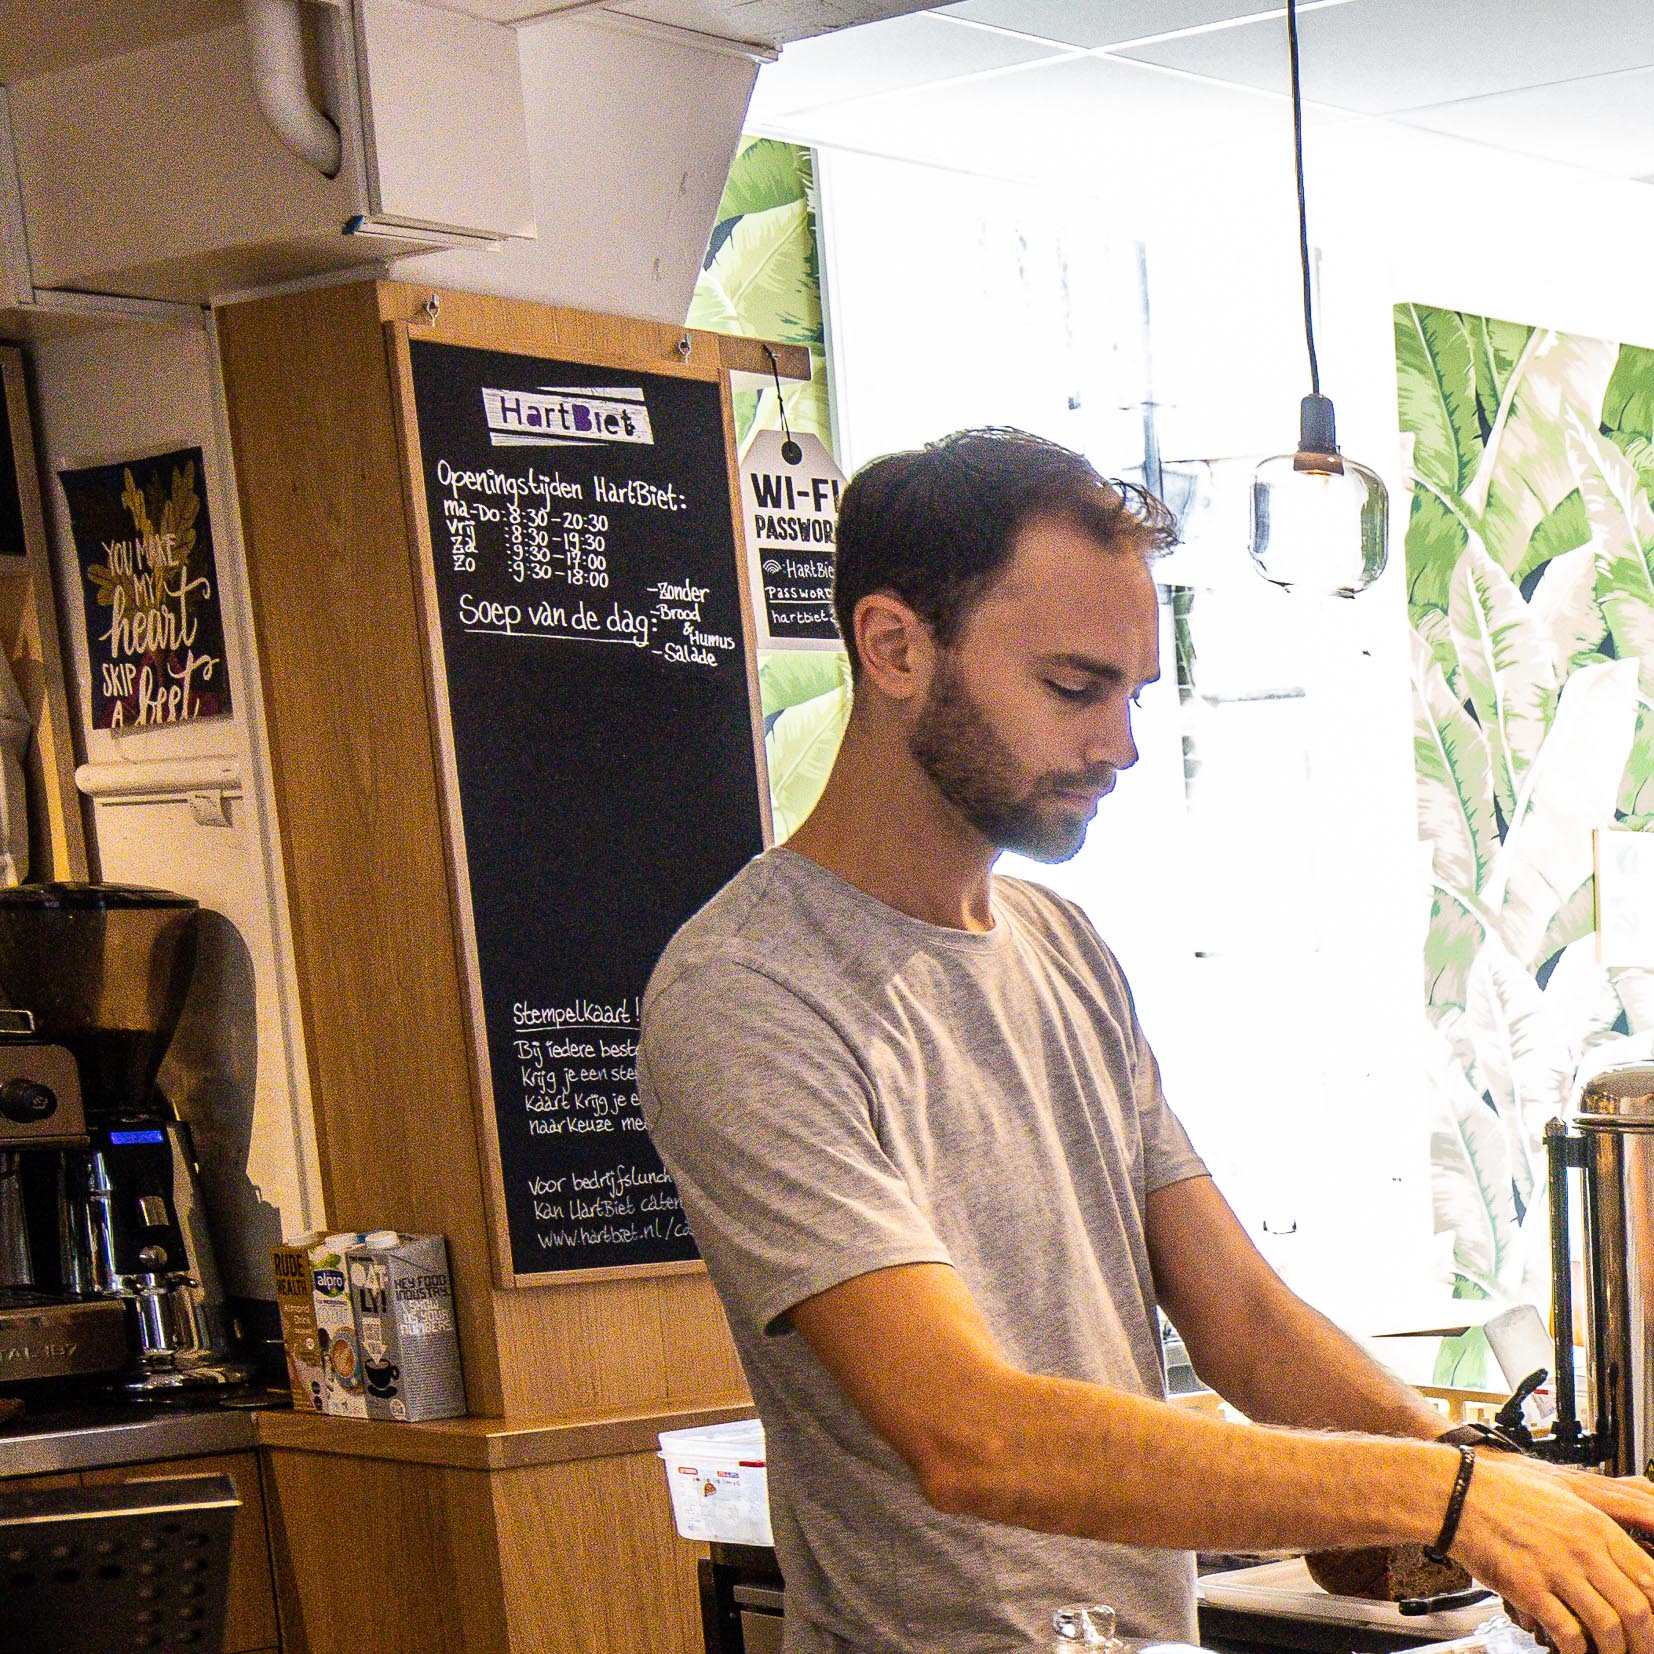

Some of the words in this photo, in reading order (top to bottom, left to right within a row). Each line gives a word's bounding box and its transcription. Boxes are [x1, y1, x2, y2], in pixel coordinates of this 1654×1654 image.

[500, 396, 636, 436] HartBiet
[438, 459, 582, 512] Openingstijden
[594, 475, 687, 511] HartBiet:
[102, 540, 132, 576] YOU
[135, 533, 179, 570] MAKE
[133, 572, 155, 608] MY
[99, 566, 210, 658] heart
[459, 594, 521, 633] Soep
[529, 602, 567, 627] van
[572, 601, 600, 630] de
[103, 664, 136, 697] SKIP
[112, 700, 123, 728] A
[513, 1040, 543, 1068] Bij
[546, 1037, 596, 1057] iedere
[563, 1068, 578, 1094] je
[580, 1068, 608, 1081] een
[611, 1065, 637, 1080] ste
[611, 1093, 627, 1114] je
[529, 1119, 567, 1135] naar
[622, 1117, 647, 1131] me
[273, 1253, 305, 1277] RUDE
[316, 1275, 344, 1291] alpro
